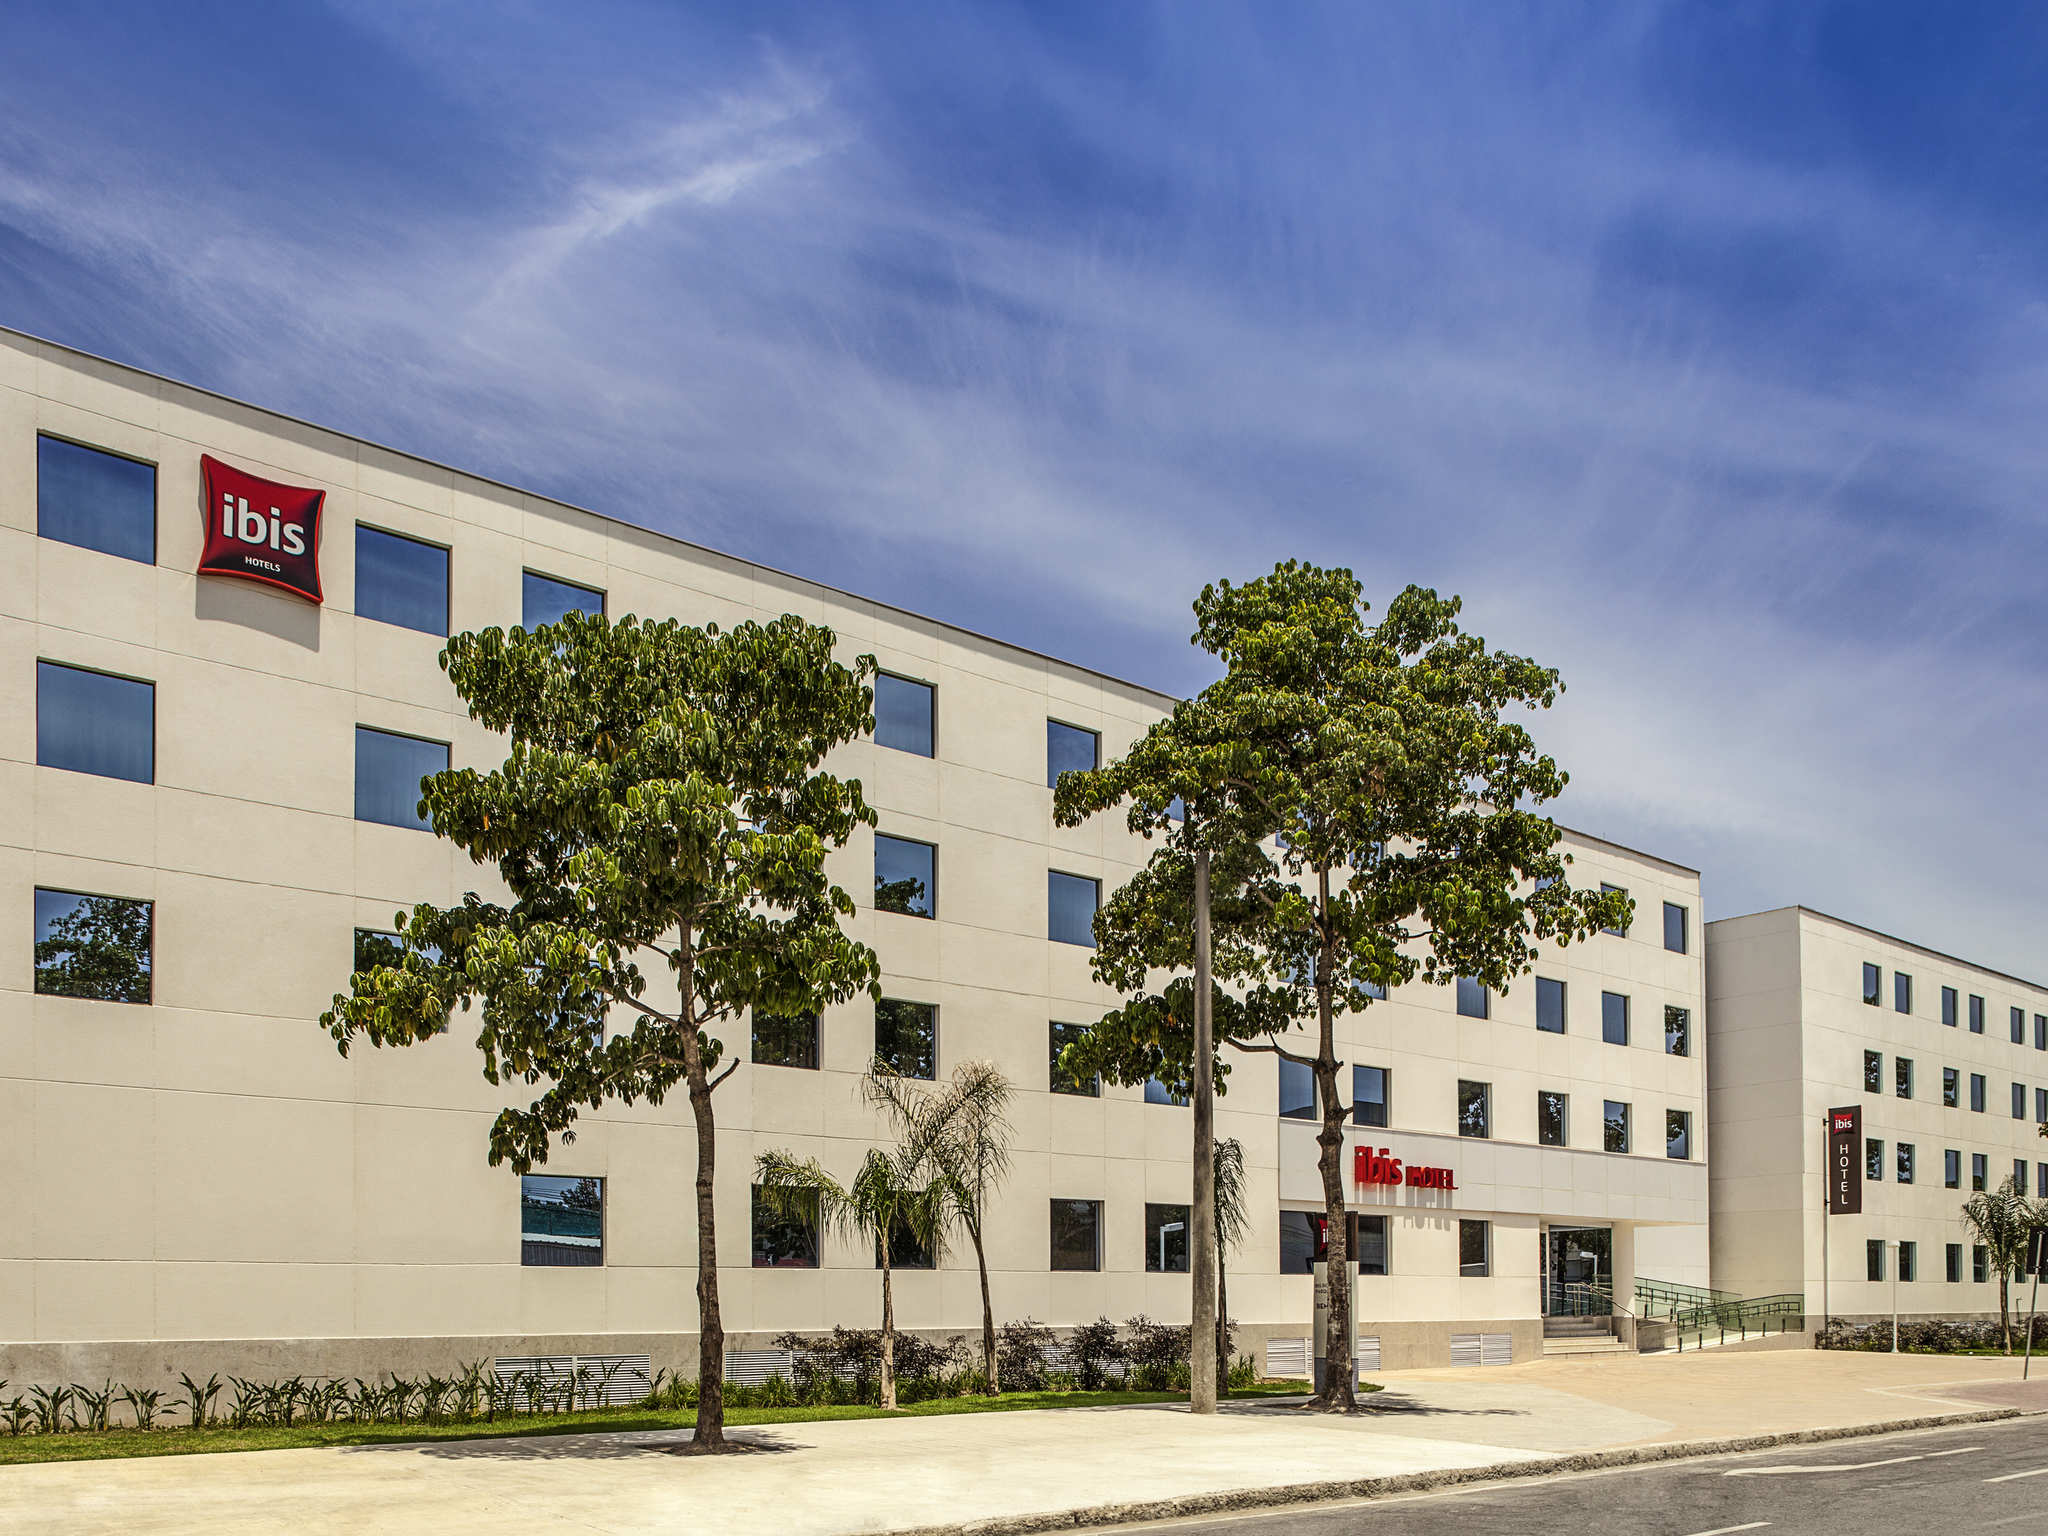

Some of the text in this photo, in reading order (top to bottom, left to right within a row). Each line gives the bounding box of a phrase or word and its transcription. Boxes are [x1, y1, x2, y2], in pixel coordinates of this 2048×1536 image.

[223, 493, 305, 556] ibis
[245, 556, 281, 572] HOTELS
[1835, 1119, 1853, 1129] ibis
[1354, 1145, 1459, 1190] ibis HOTEL
[1839, 1144, 1849, 1205] HOTEL
